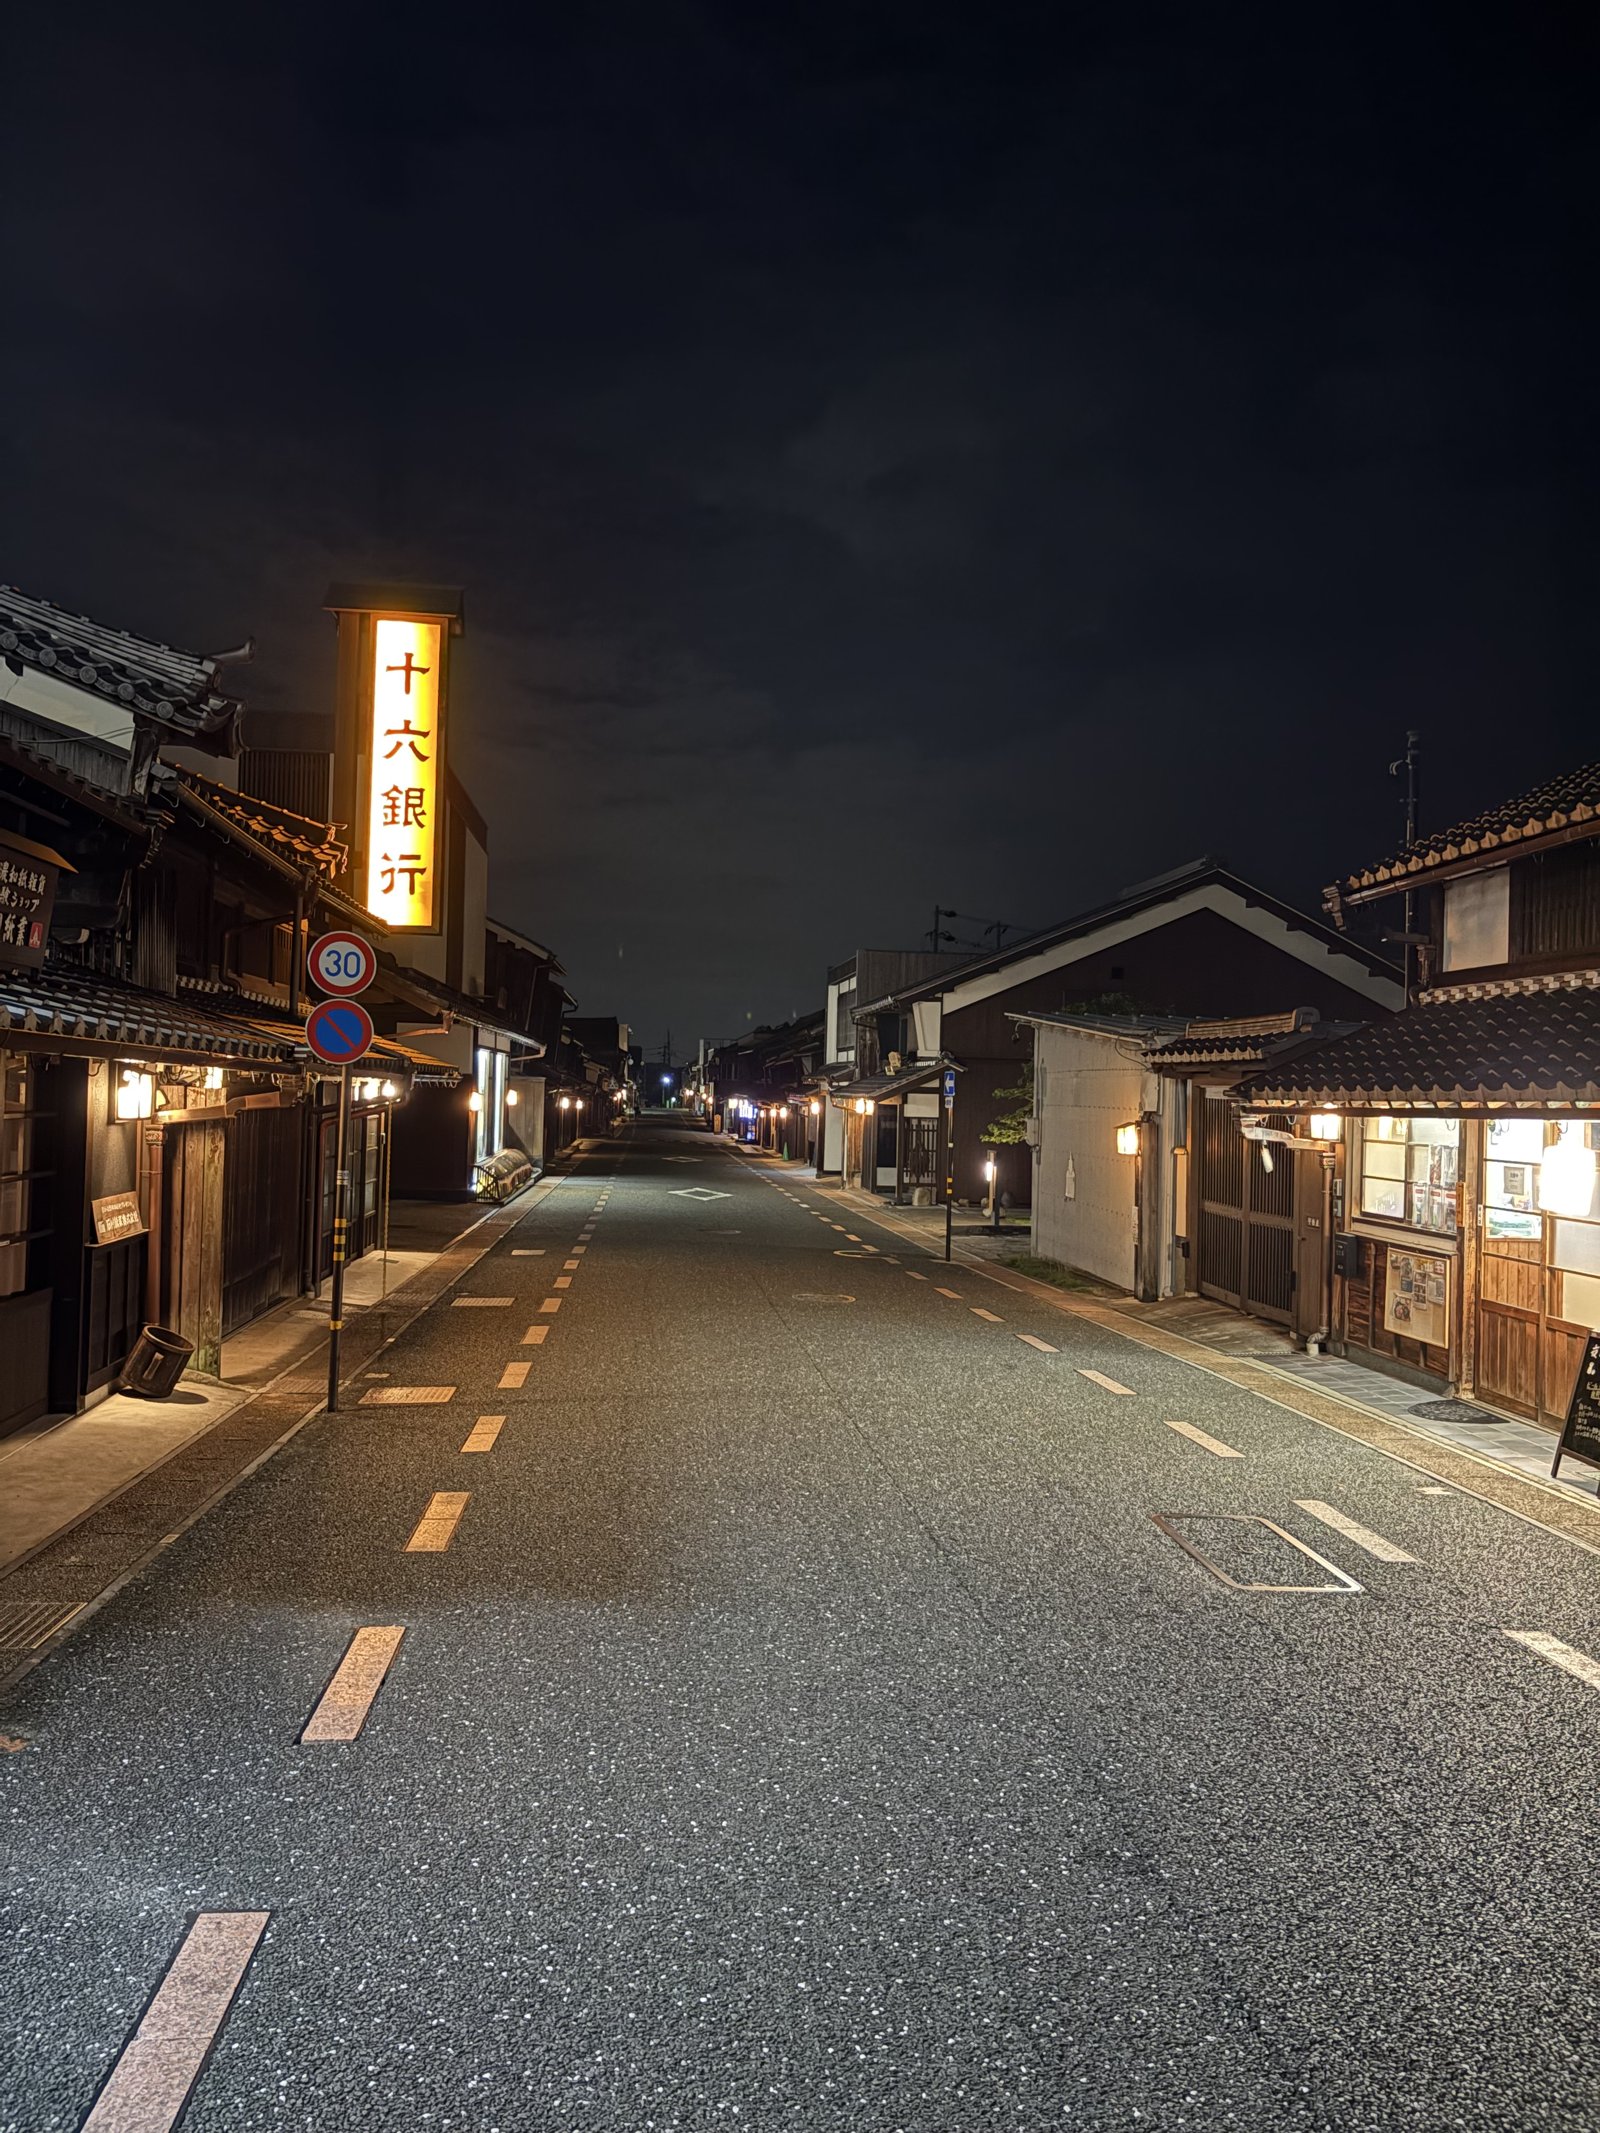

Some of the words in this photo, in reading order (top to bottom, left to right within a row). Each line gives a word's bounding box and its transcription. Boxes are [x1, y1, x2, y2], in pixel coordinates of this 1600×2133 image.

[380, 652, 431, 896] 十六銀行
[325, 949, 360, 978] 30
